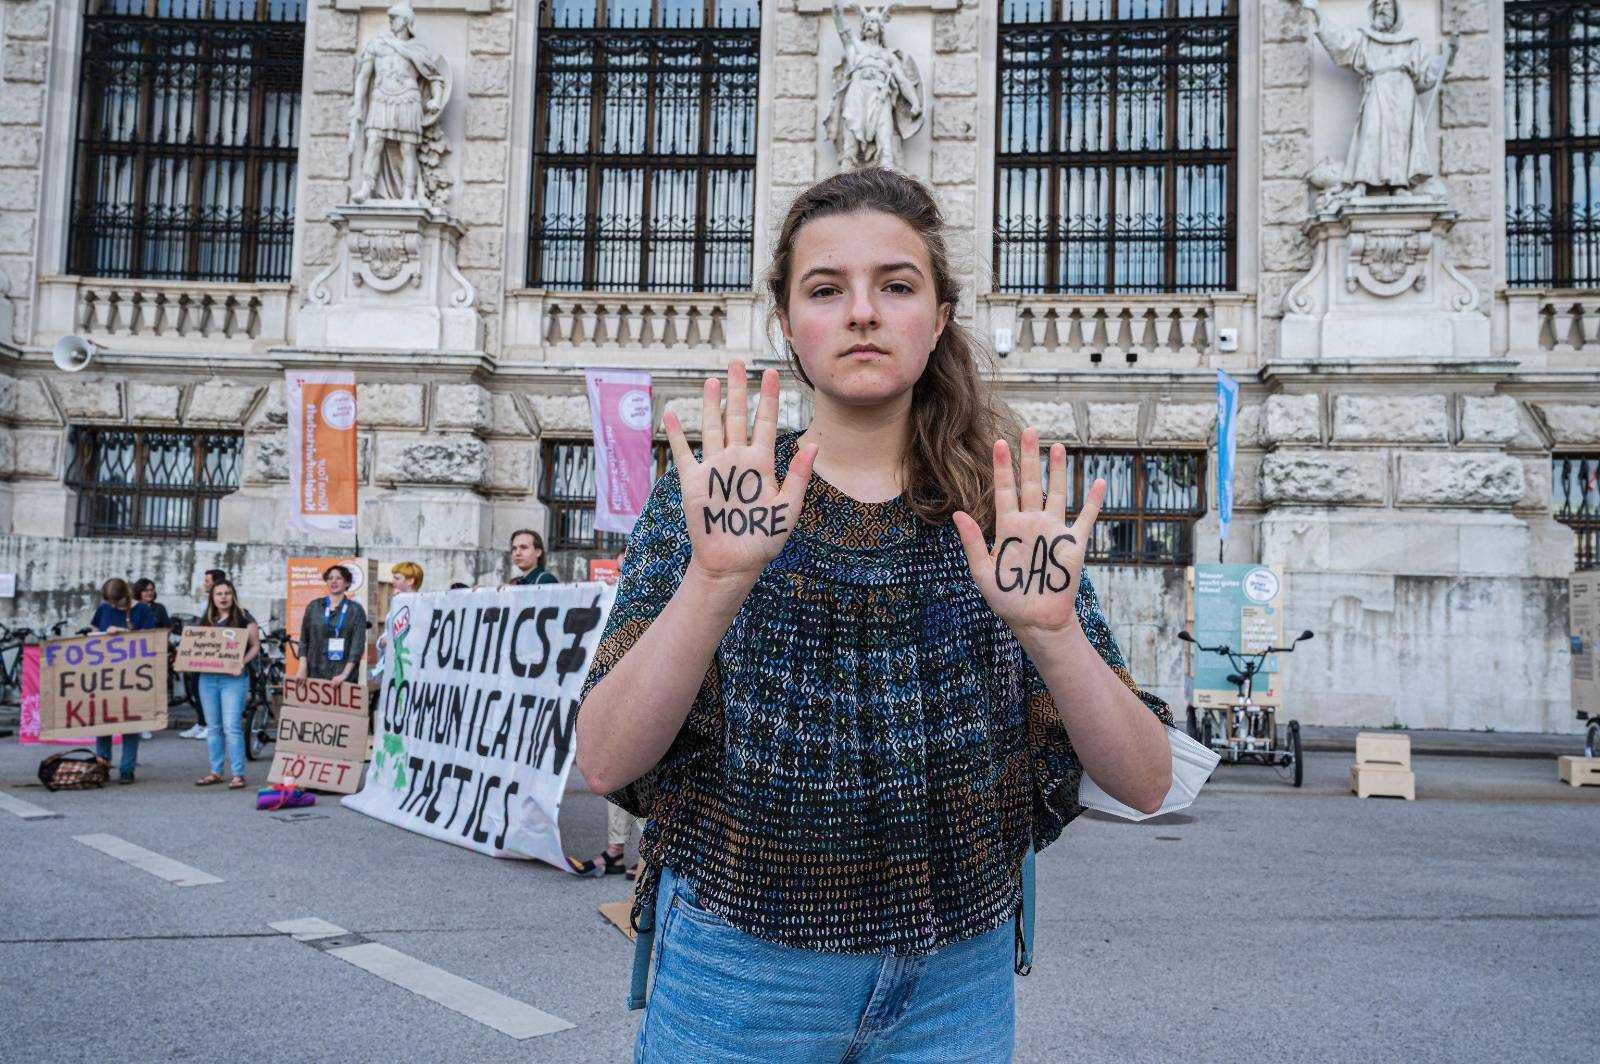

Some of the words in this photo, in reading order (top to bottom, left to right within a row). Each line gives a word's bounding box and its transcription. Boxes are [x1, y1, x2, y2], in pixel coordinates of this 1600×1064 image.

[708, 465, 763, 504] NO
[703, 503, 789, 538] MORE
[995, 534, 1076, 595] GAS
[45, 637, 157, 667] FOSSIL
[420, 606, 559, 679] POLITICS
[60, 664, 154, 697] FUELS
[279, 718, 350, 749] ENERGIE
[281, 755, 352, 785] TÖTET
[398, 756, 519, 850] TACTICS
